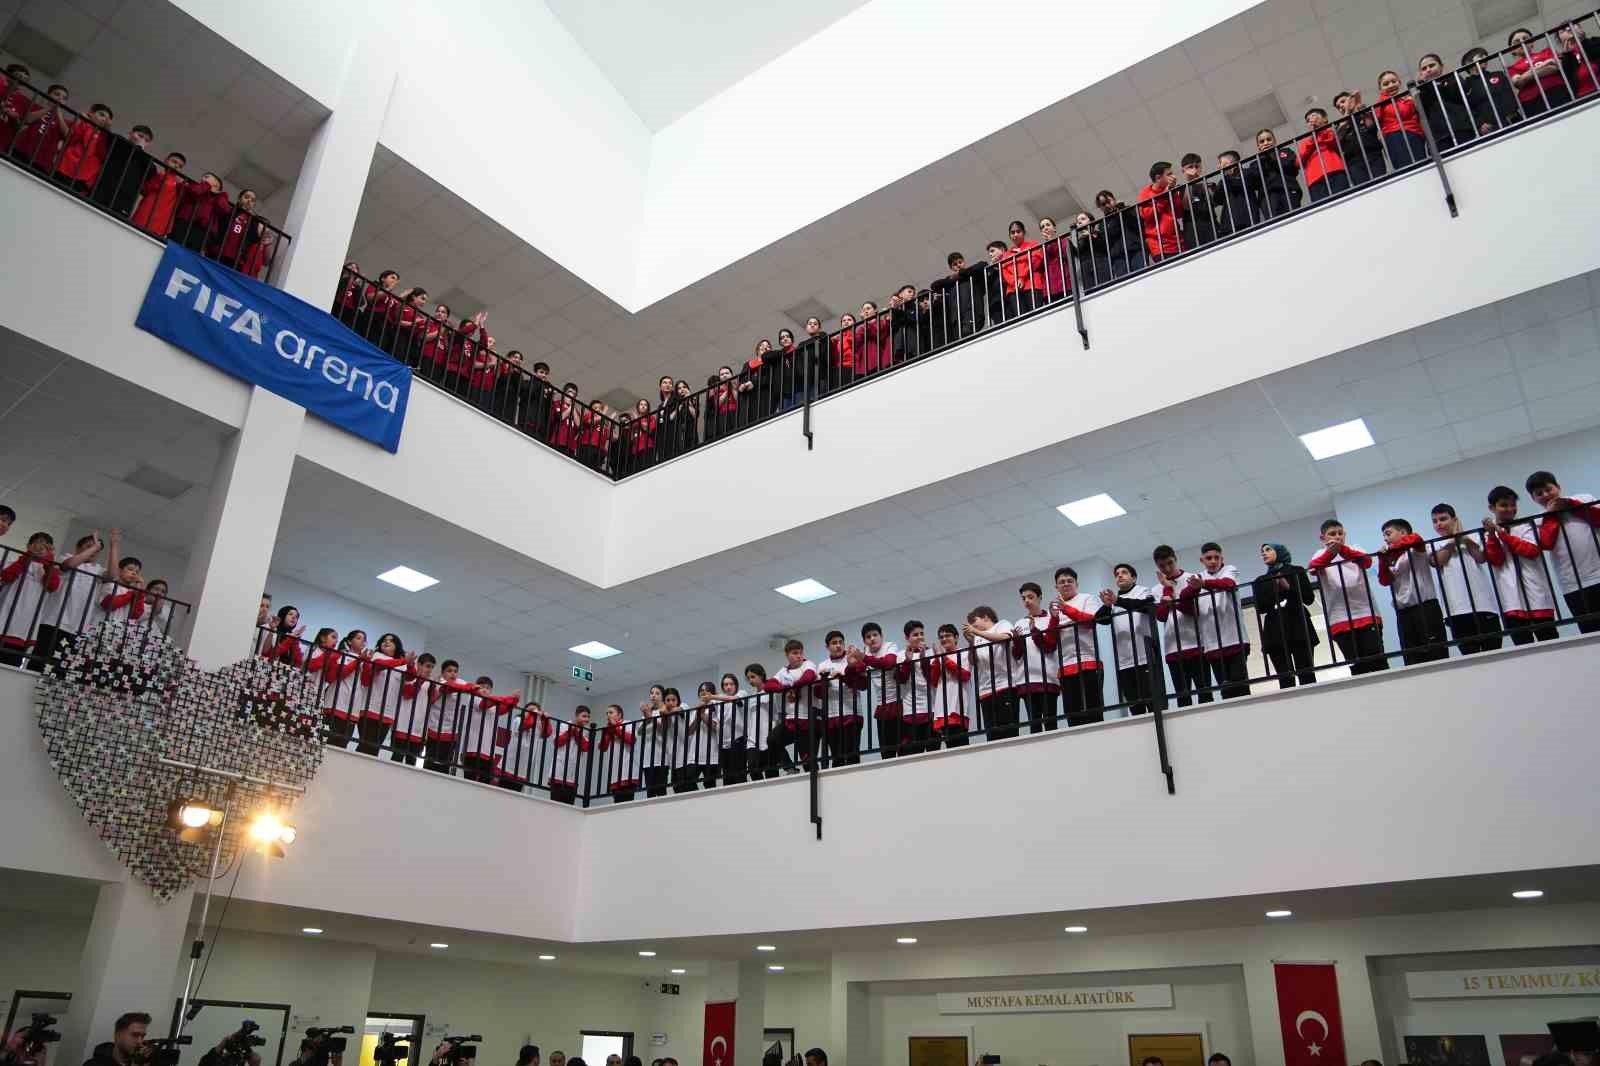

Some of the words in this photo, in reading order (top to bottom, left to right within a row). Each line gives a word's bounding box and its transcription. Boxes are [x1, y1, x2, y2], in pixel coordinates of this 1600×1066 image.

[164, 266, 262, 344] FIFA
[274, 329, 400, 413] arena
[1463, 976, 1480, 991] 15
[1486, 974, 1574, 990] TEMMUZ
[967, 993, 1023, 1008] MUSTAFA
[1024, 992, 1071, 1006] KEMAL
[1073, 989, 1135, 1005] ATATÜRK
